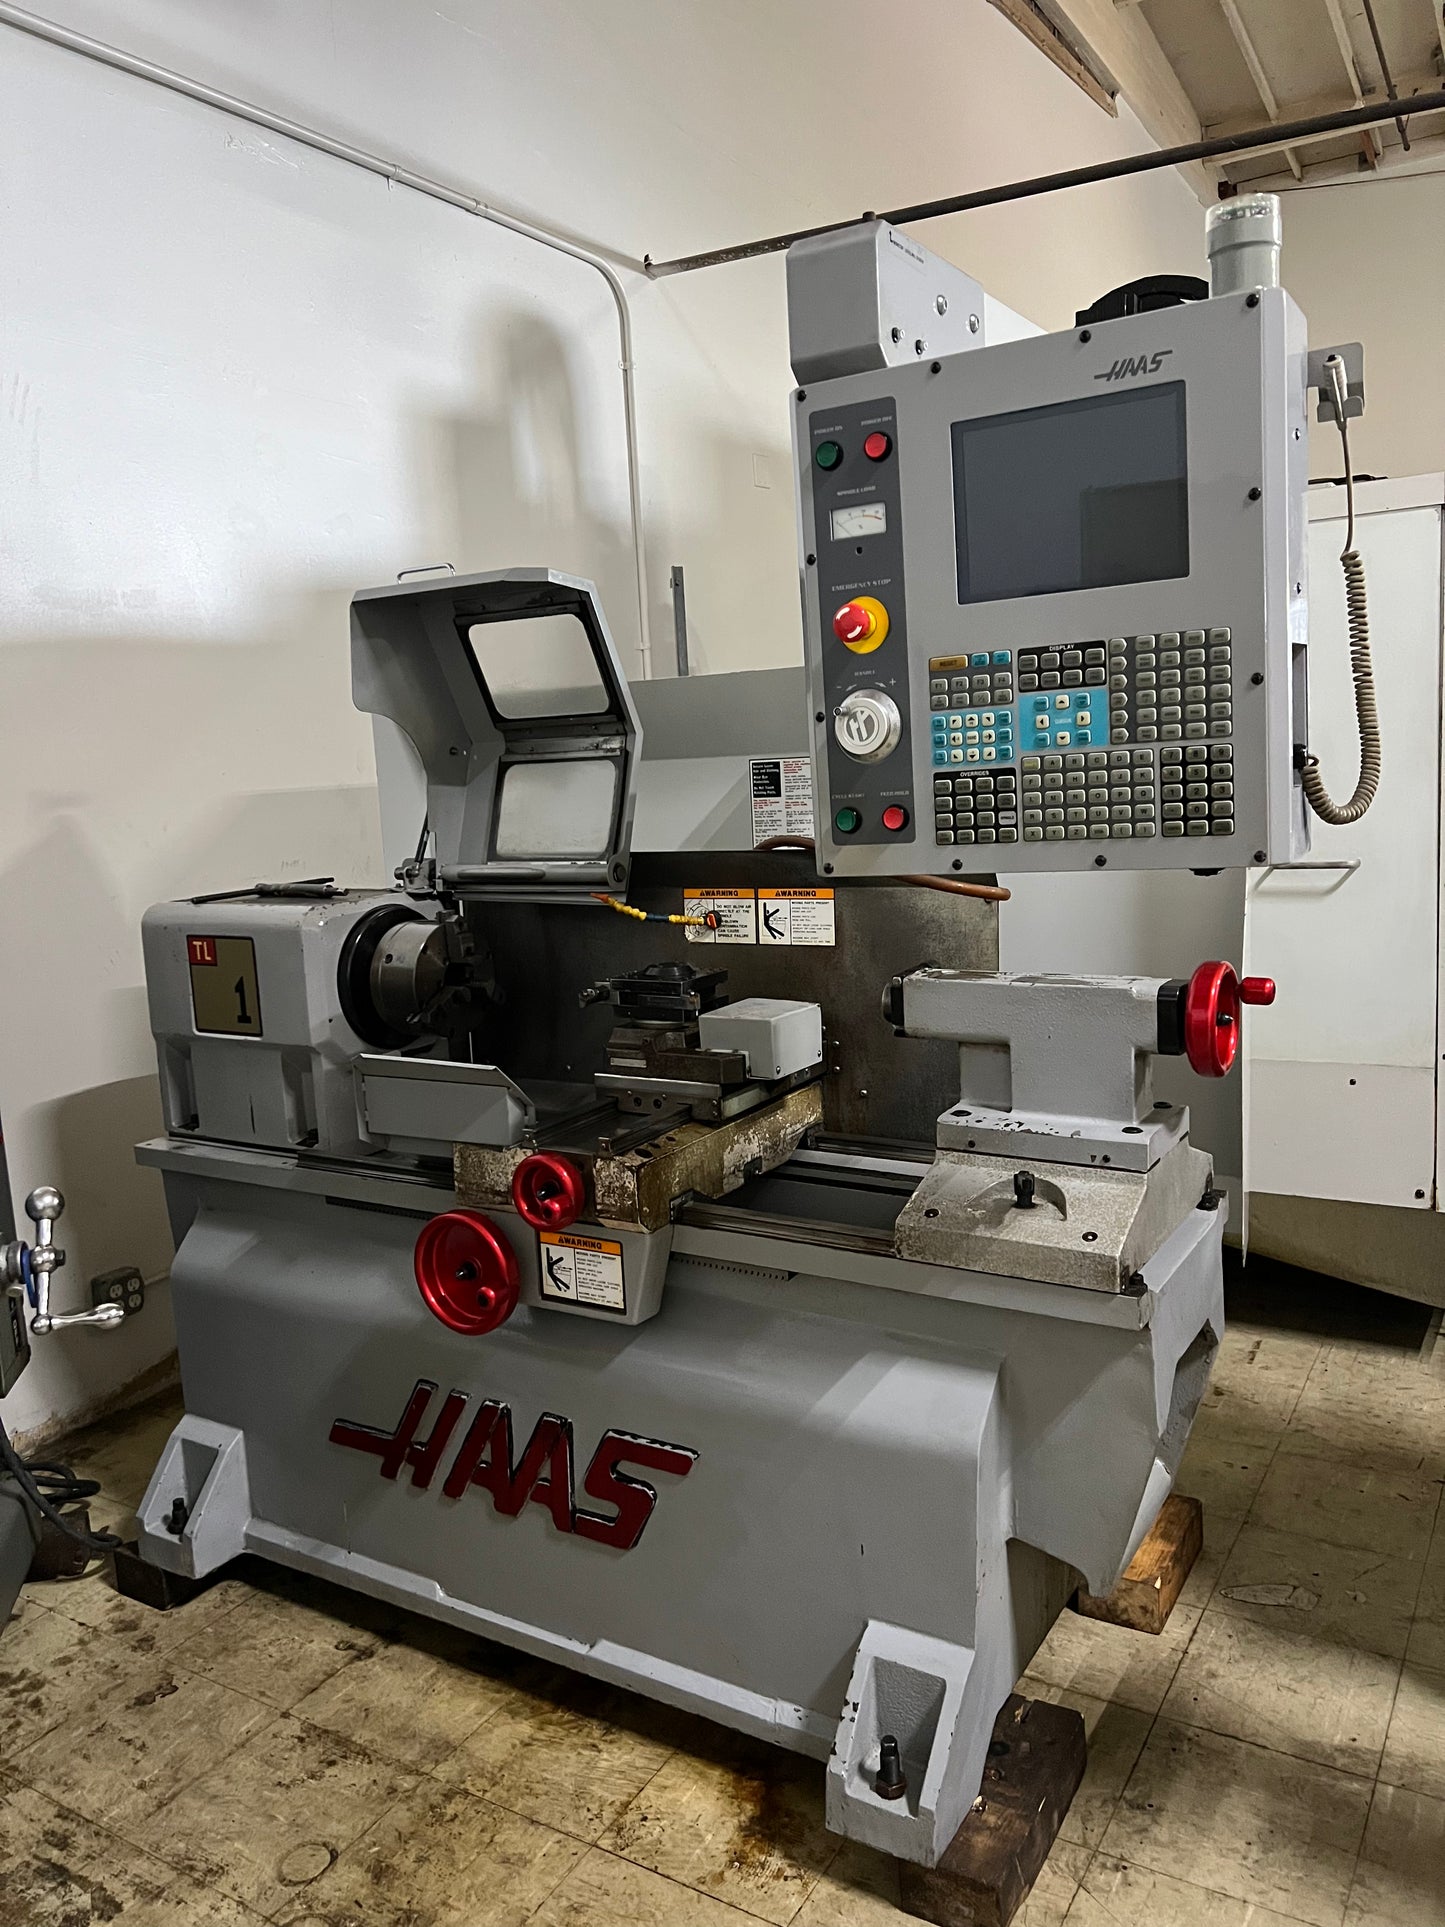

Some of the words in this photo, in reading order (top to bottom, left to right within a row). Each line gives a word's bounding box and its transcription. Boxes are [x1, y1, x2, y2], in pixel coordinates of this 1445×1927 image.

[1094, 350, 1173, 382] HAAS
[832, 581, 871, 591] EMERGENCY
[192, 941, 212, 961] TL
[234, 976, 252, 1024] 1
[564, 1237, 602, 1250] WARNING
[328, 1378, 700, 1550] HAAS
